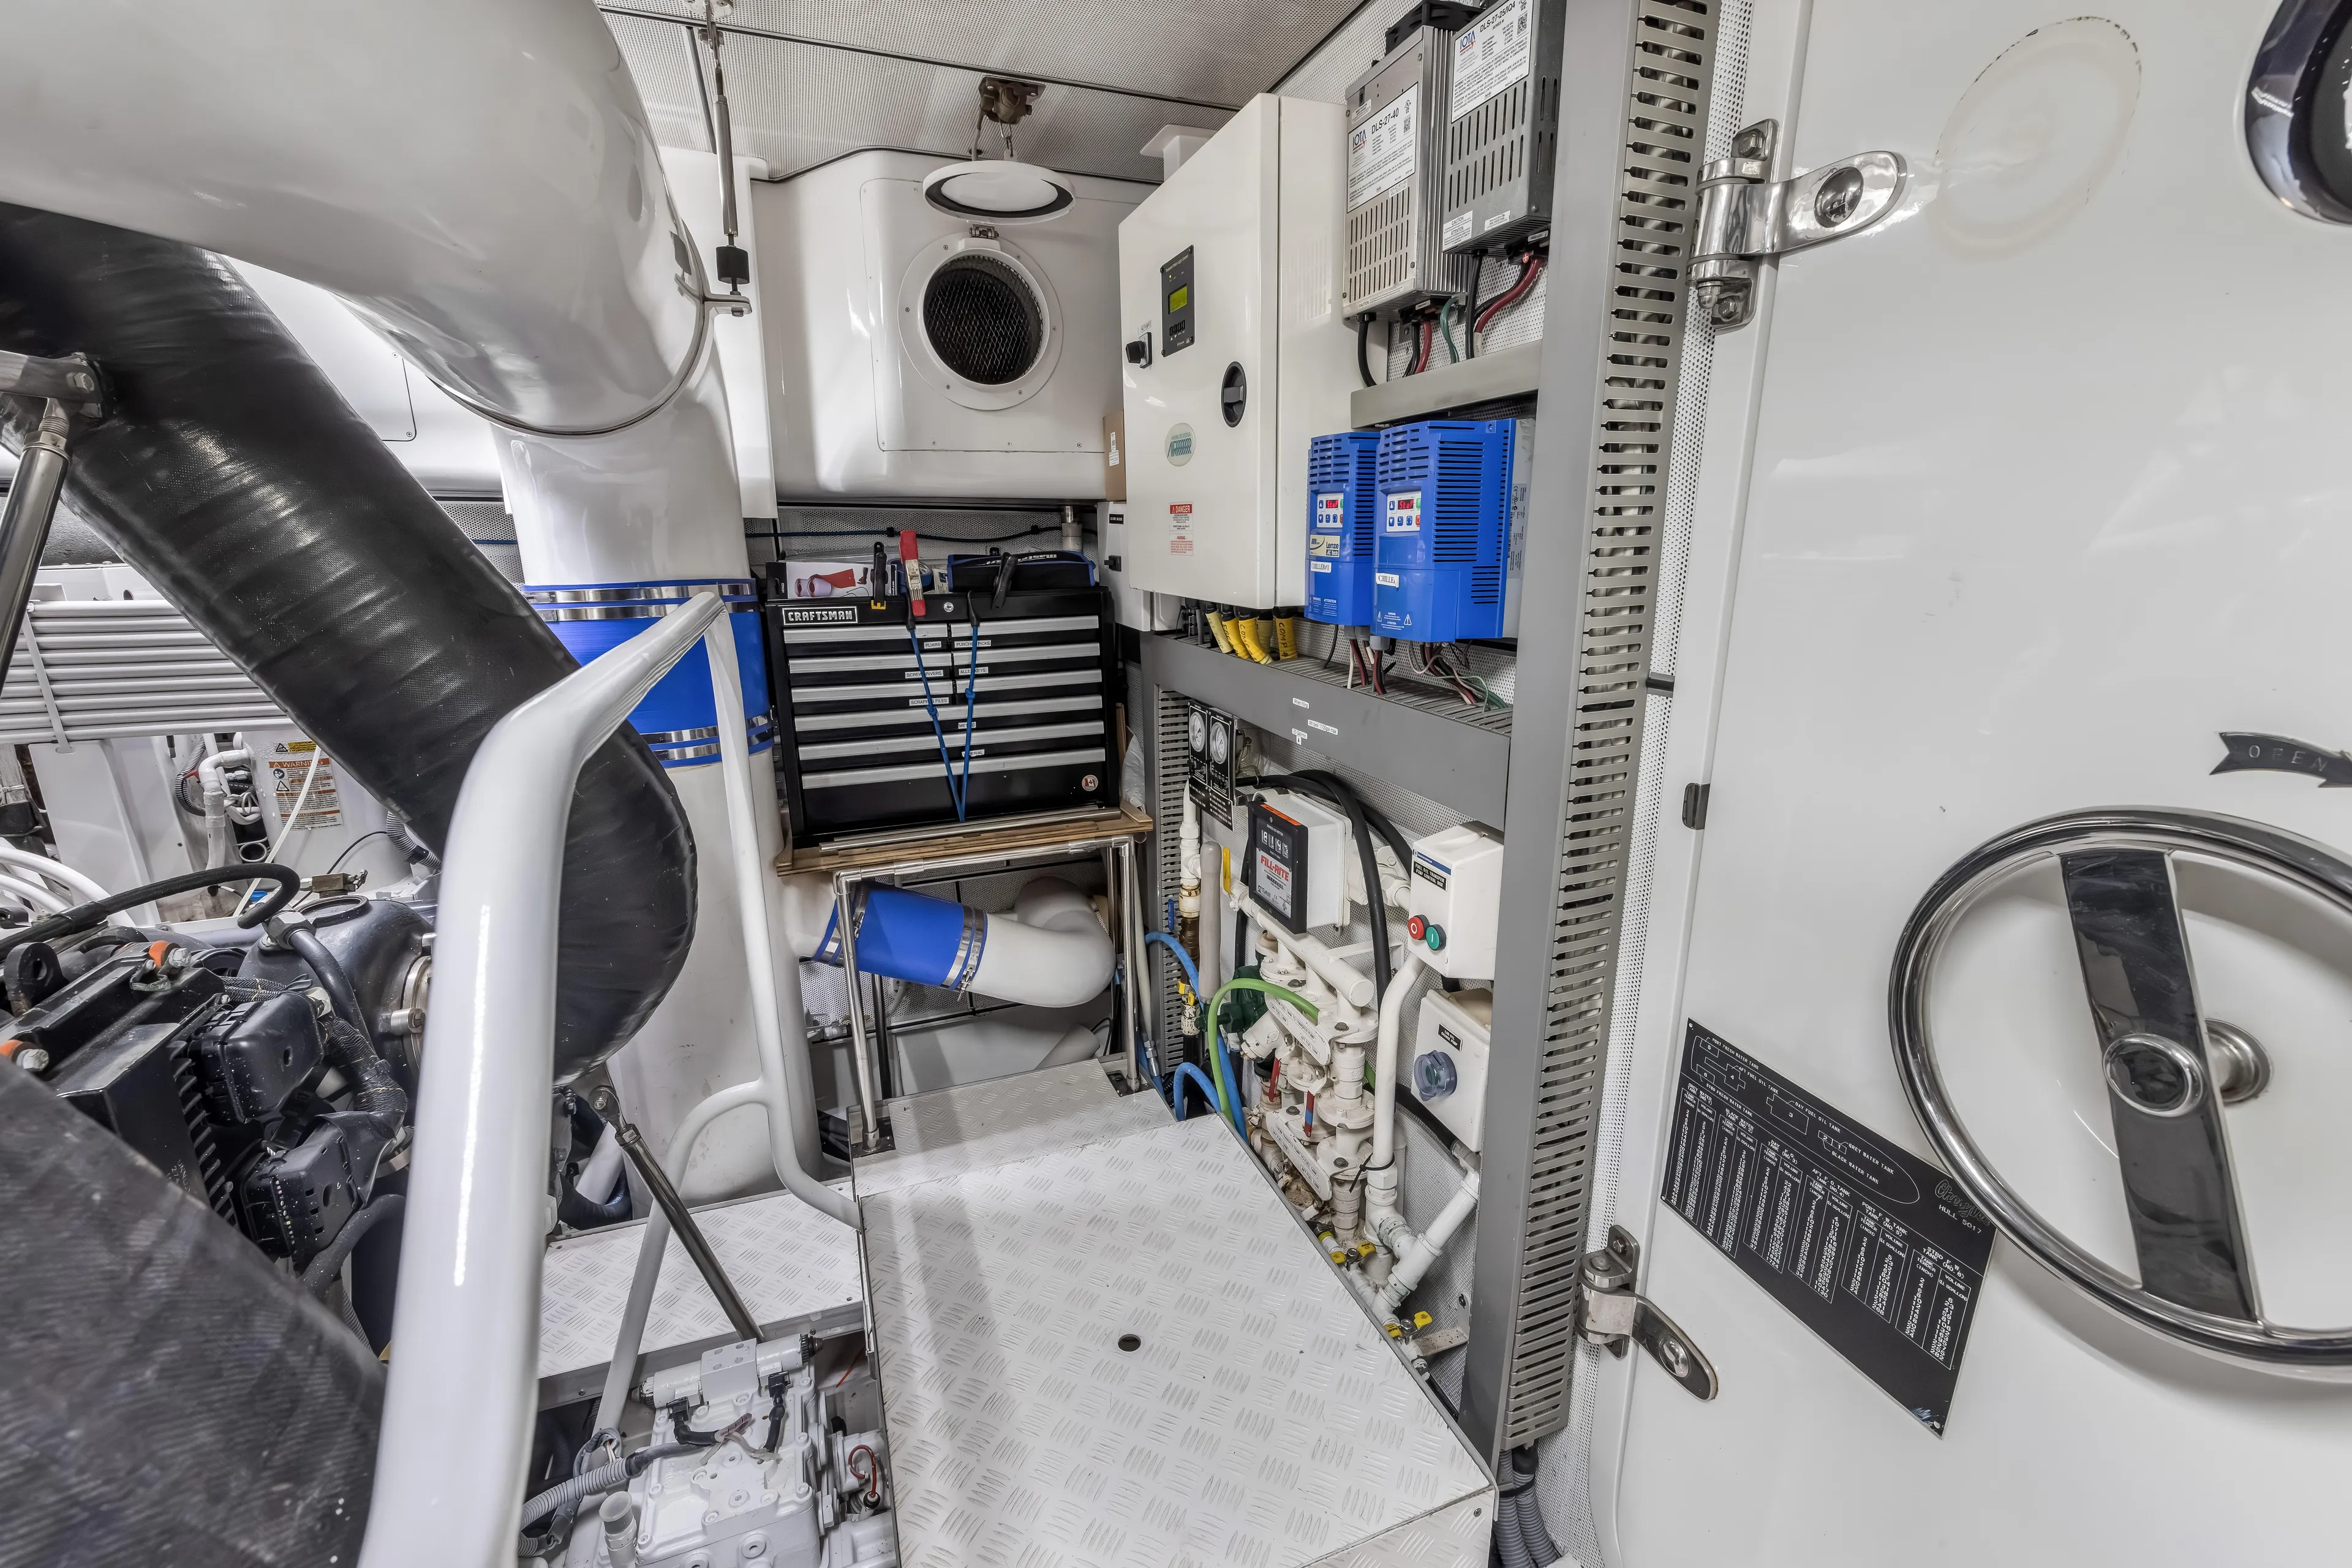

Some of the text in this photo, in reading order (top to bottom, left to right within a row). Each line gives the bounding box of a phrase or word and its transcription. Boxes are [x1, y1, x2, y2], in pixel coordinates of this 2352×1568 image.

[1460, 30, 1476, 50] IOTA
[1372, 108, 1399, 134] DLS-27-40
[1352, 129, 1366, 148] IOTA
[1451, 227, 1464, 235] ATTENTION
[1452, 217, 1464, 225] CAUTION
[789, 610, 853, 621] CRAFTSMAN
[1279, 622, 1287, 648] COMP
[282, 759, 323, 767] WARNIG
[2249, 745, 2328, 772] OPEN
[1261, 855, 1289, 882] FILL-RITE
[1423, 873, 1436, 884] CONTROL
[1430, 871, 1444, 883] TRANSFER
[1296, 1019, 1308, 1034] TRANSFER
[1722, 1044, 1735, 1054] FRESH
[1735, 1052, 1747, 1063] WATER
[1749, 1061, 1758, 1069] TANK
[1747, 1071, 1757, 1080] FUEL
[1768, 1085, 1778, 1094] TANK
[1706, 1083, 1752, 1117] STBD FRESH WATER TANK
[1805, 1108, 1816, 1118] FUEL
[1829, 1123, 1841, 1133] TANK
[1831, 1151, 1879, 1184] BLACK WATER TANK
[1849, 1143, 1894, 1174] GREY WATER TANK
[1862, 1202, 1875, 1213] PORT
[1893, 1222, 1907, 1235] TANK
[1866, 1208, 1879, 1221] TANK
[1883, 1221, 1894, 1231] (NO.
[1939, 1204, 1981, 1234] HULL 5017
[1923, 1248, 1938, 1261] TANK
[1942, 1262, 1955, 1273] (NO.
[1927, 1246, 1943, 1259] STBD
[1913, 1300, 1951, 1331] 12 106
[1942, 1311, 1951, 1319] 59
[1944, 1300, 1954, 1310] 23
[1909, 1315, 1947, 1346] 18 195
[1910, 1310, 1948, 1341] 16 163
[1912, 1305, 1950, 1336] 14 132
[1941, 1316, 1950, 1324] 81
[1905, 1329, 1943, 1361] 24 282
[1906, 1324, 1945, 1355] 22 255
[1907, 1320, 1946, 1351] 20 227
